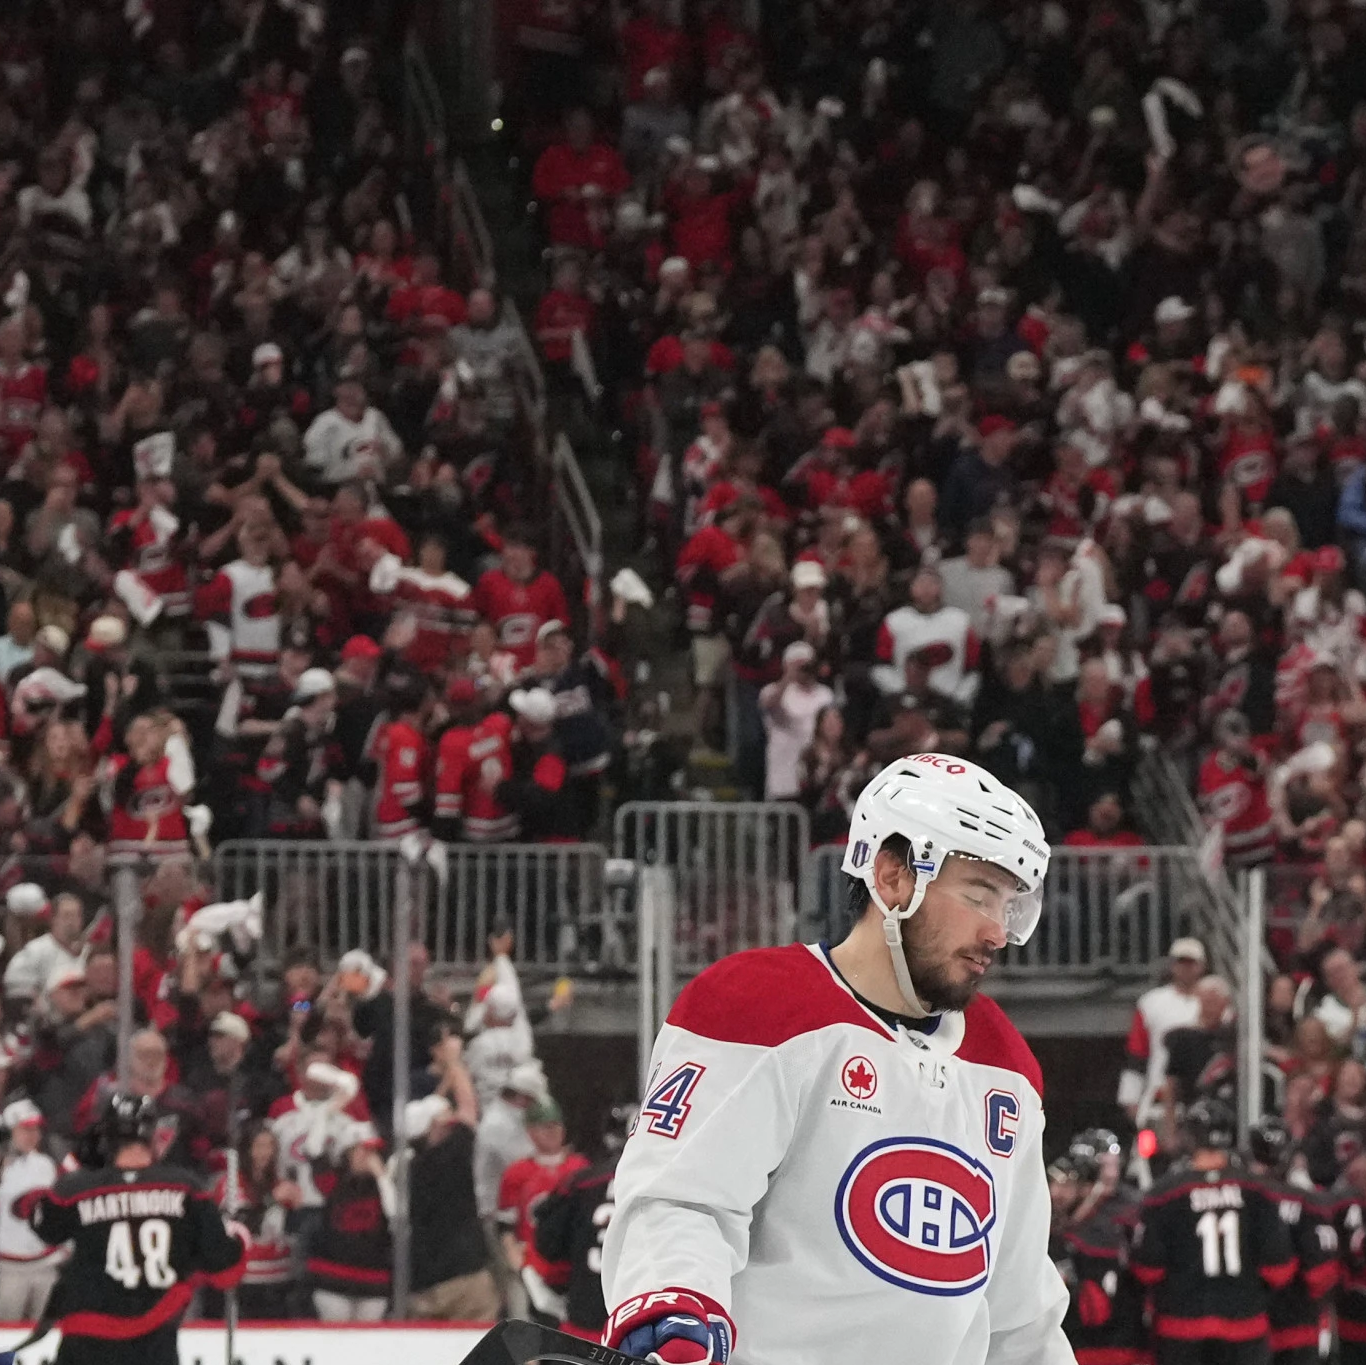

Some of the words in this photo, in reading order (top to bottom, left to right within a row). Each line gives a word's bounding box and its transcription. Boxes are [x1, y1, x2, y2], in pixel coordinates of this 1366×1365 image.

[628, 1060, 708, 1141] 4
[830, 1098, 848, 1108] AIR
[850, 1101, 882, 1115] CANADA
[984, 1087, 1021, 1159] C
[104, 1218, 178, 1290] 48
[1195, 1209, 1243, 1279] 11
